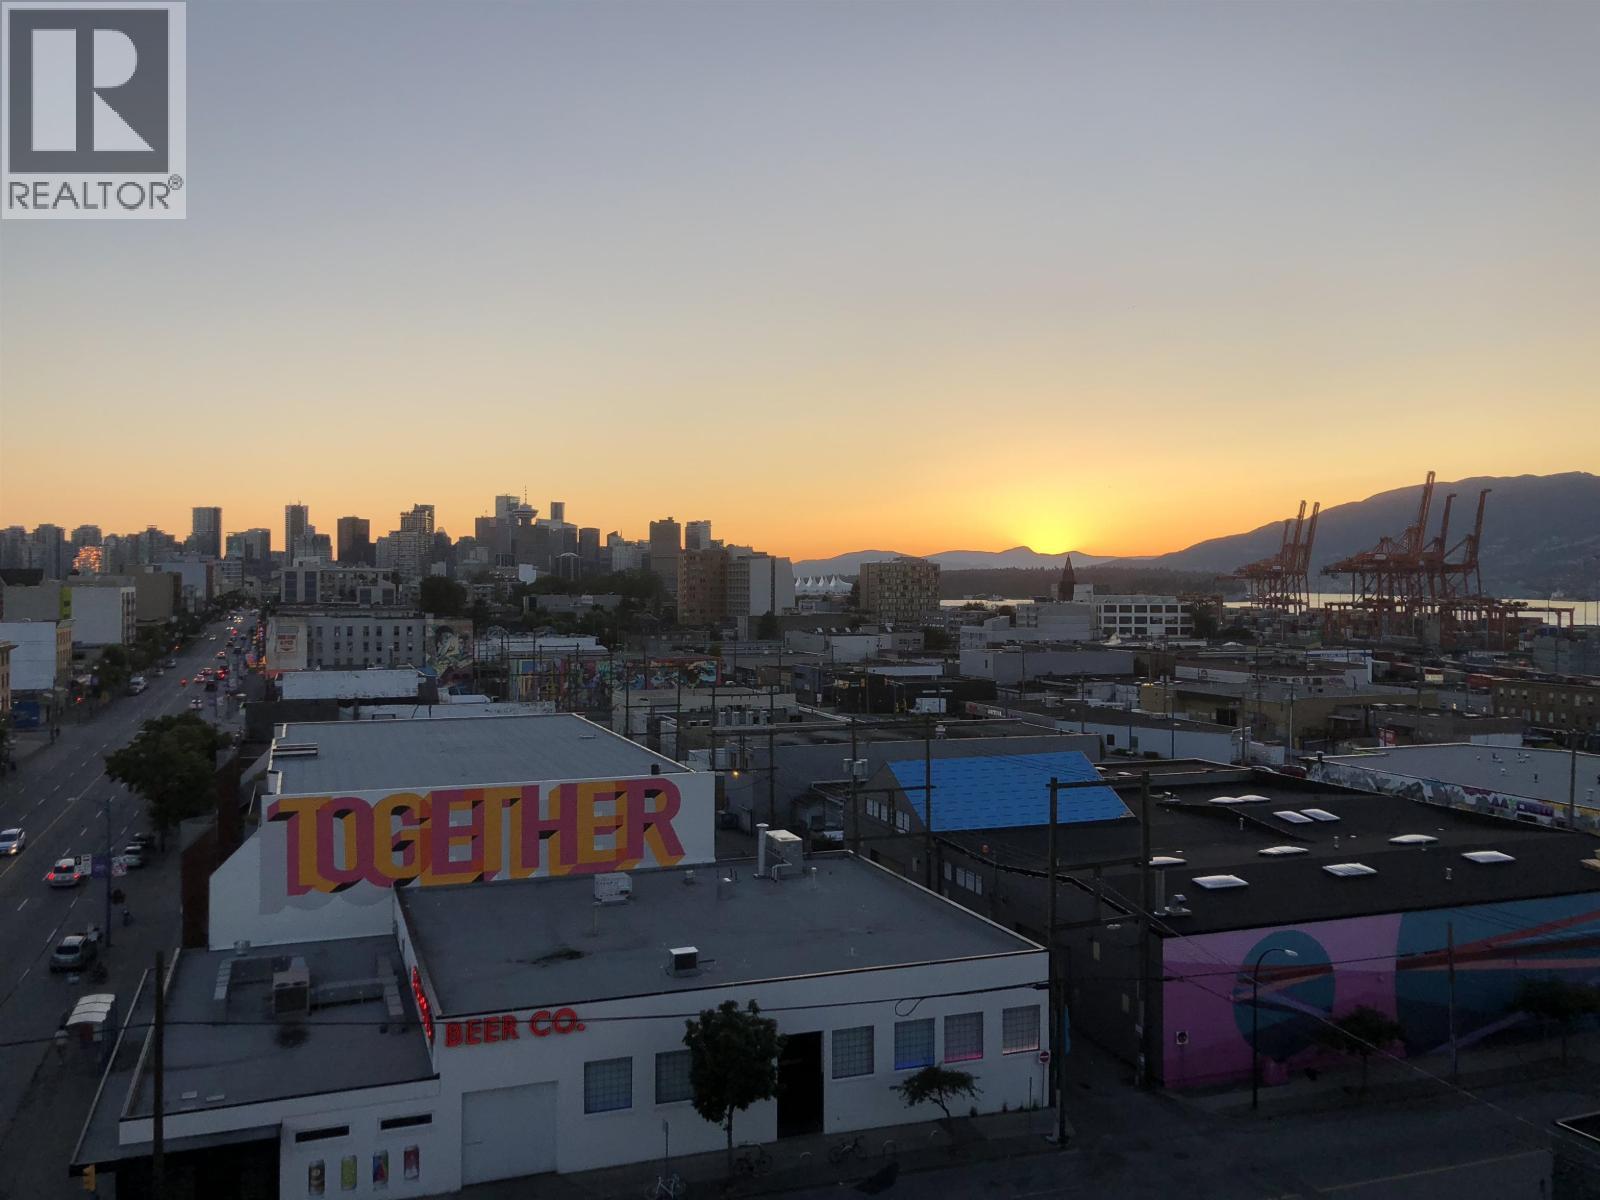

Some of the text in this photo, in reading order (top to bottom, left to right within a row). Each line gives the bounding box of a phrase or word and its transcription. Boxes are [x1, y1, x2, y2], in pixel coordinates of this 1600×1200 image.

[267, 778, 686, 896] TOGETHER
[445, 1008, 586, 1047] BEER CO.
